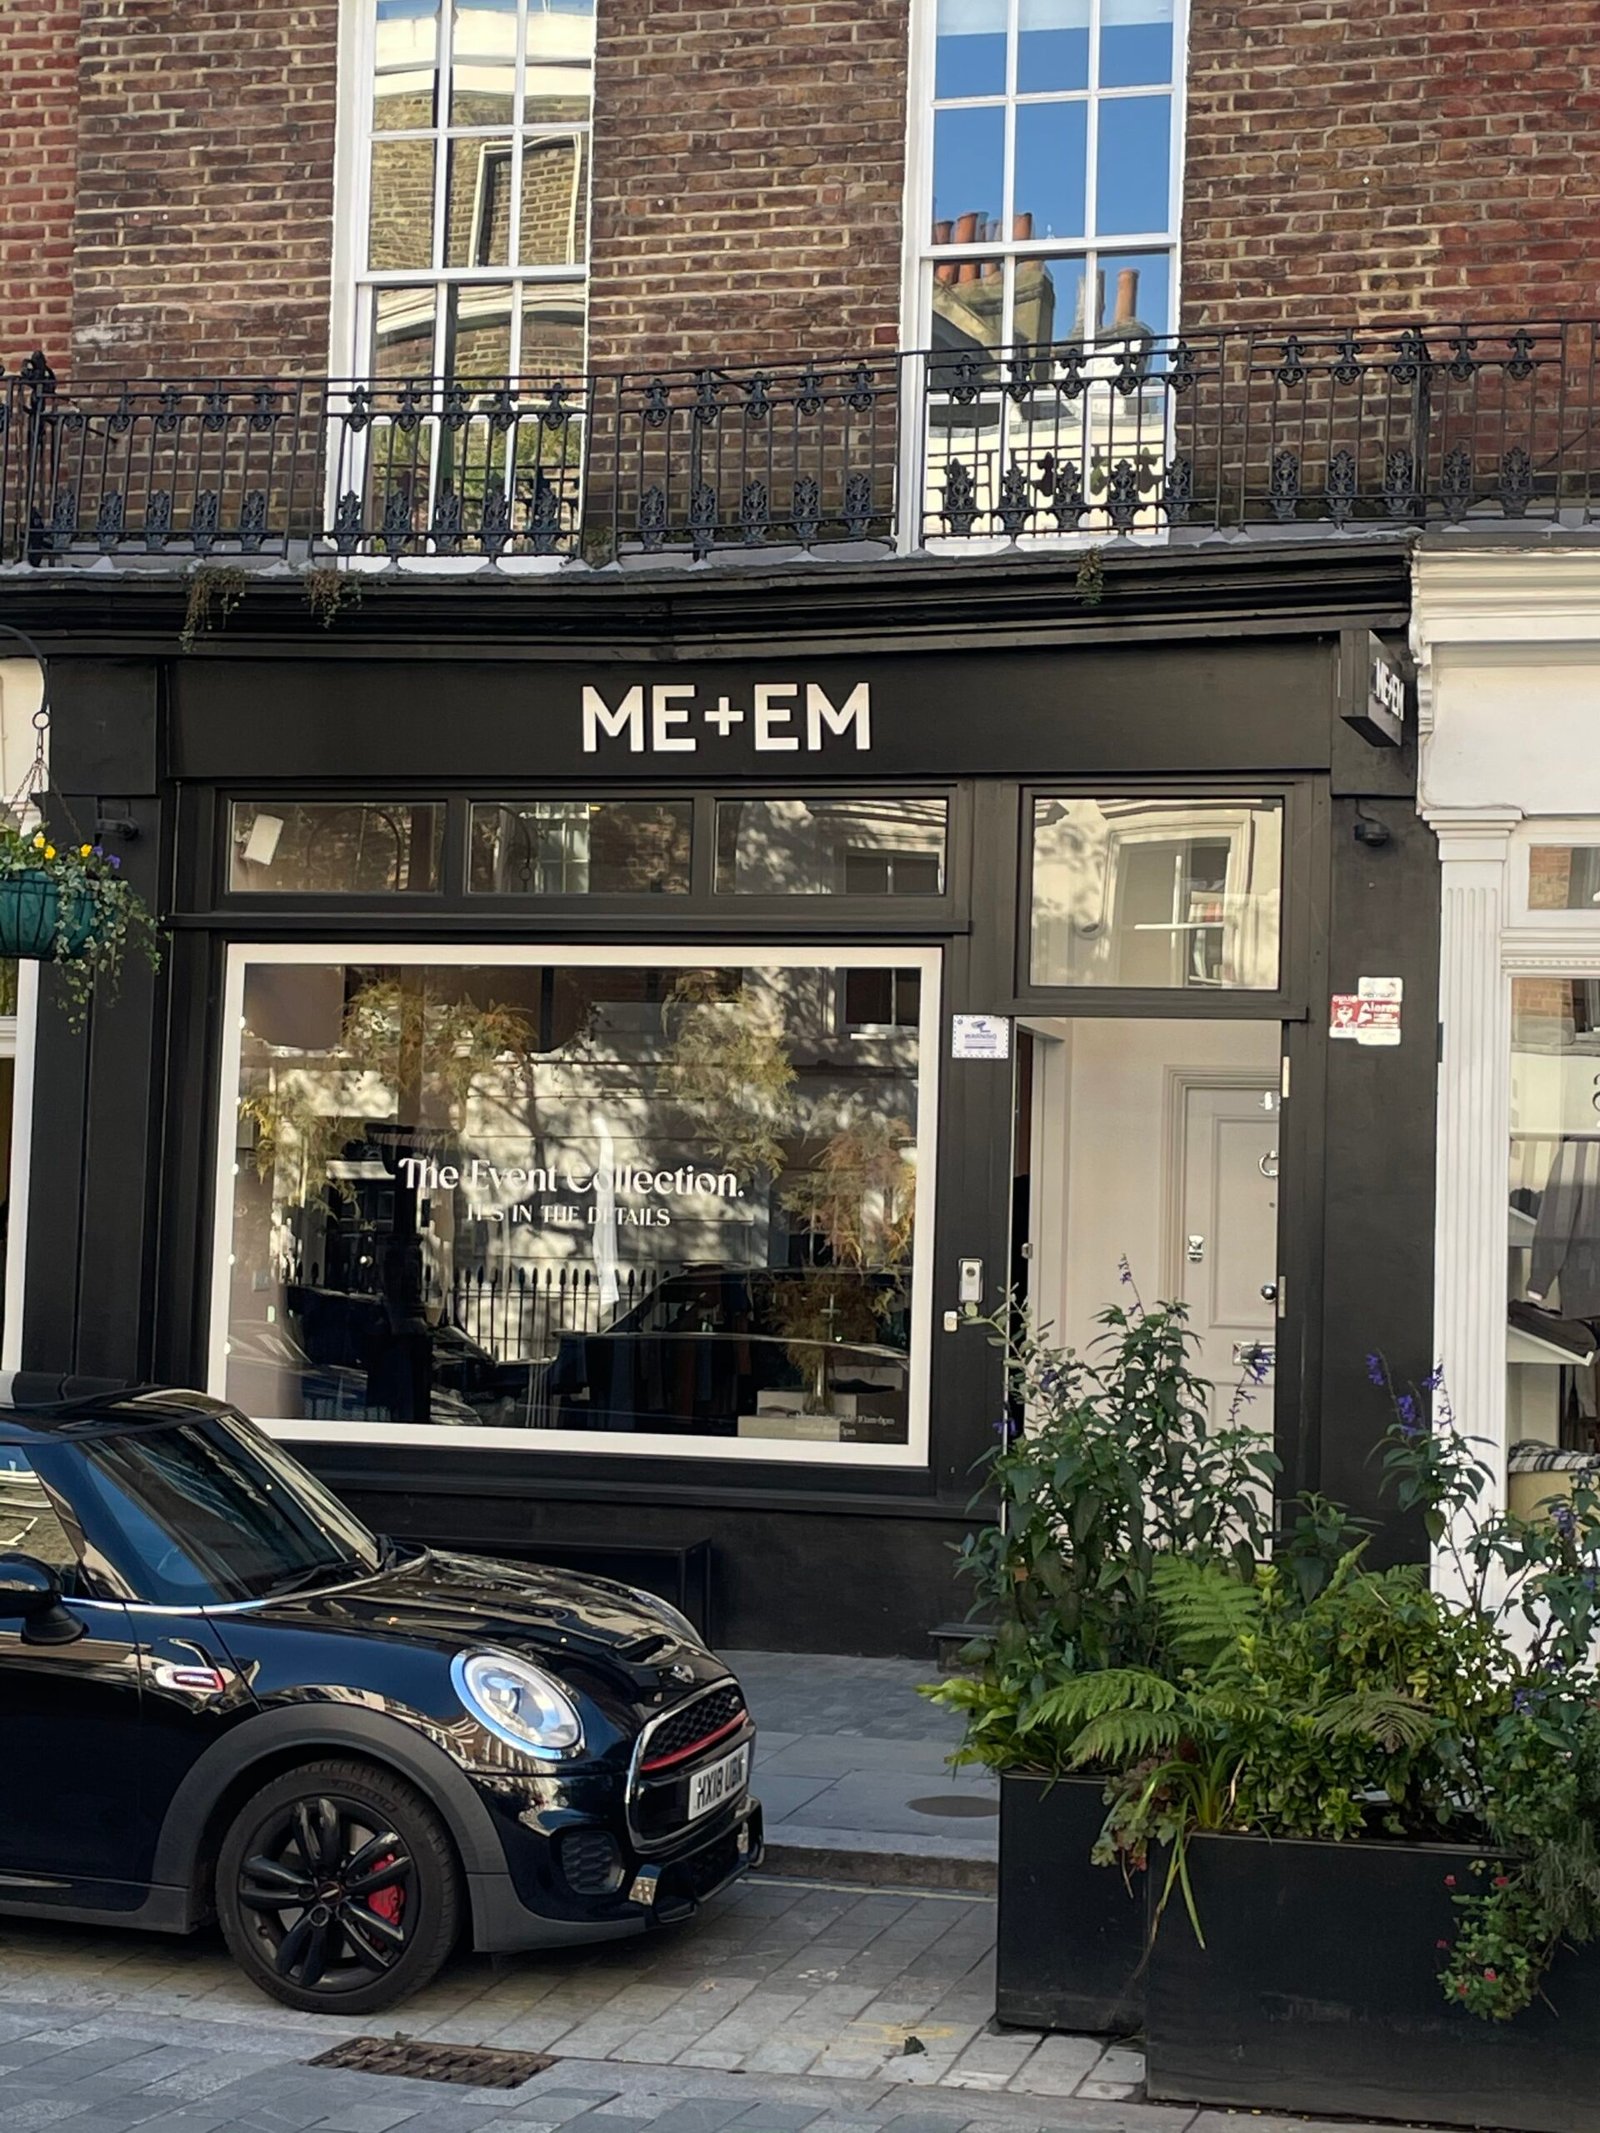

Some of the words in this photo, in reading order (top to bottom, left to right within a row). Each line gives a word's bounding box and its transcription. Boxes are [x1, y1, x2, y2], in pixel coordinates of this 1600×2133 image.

[582, 682, 871, 752] ME+EM
[398, 1157, 459, 1190] The
[470, 1158, 557, 1192] Event
[566, 1163, 745, 1198] Collection.
[468, 1203, 504, 1222] ITS
[512, 1204, 533, 1223] IN
[540, 1206, 580, 1224] THE
